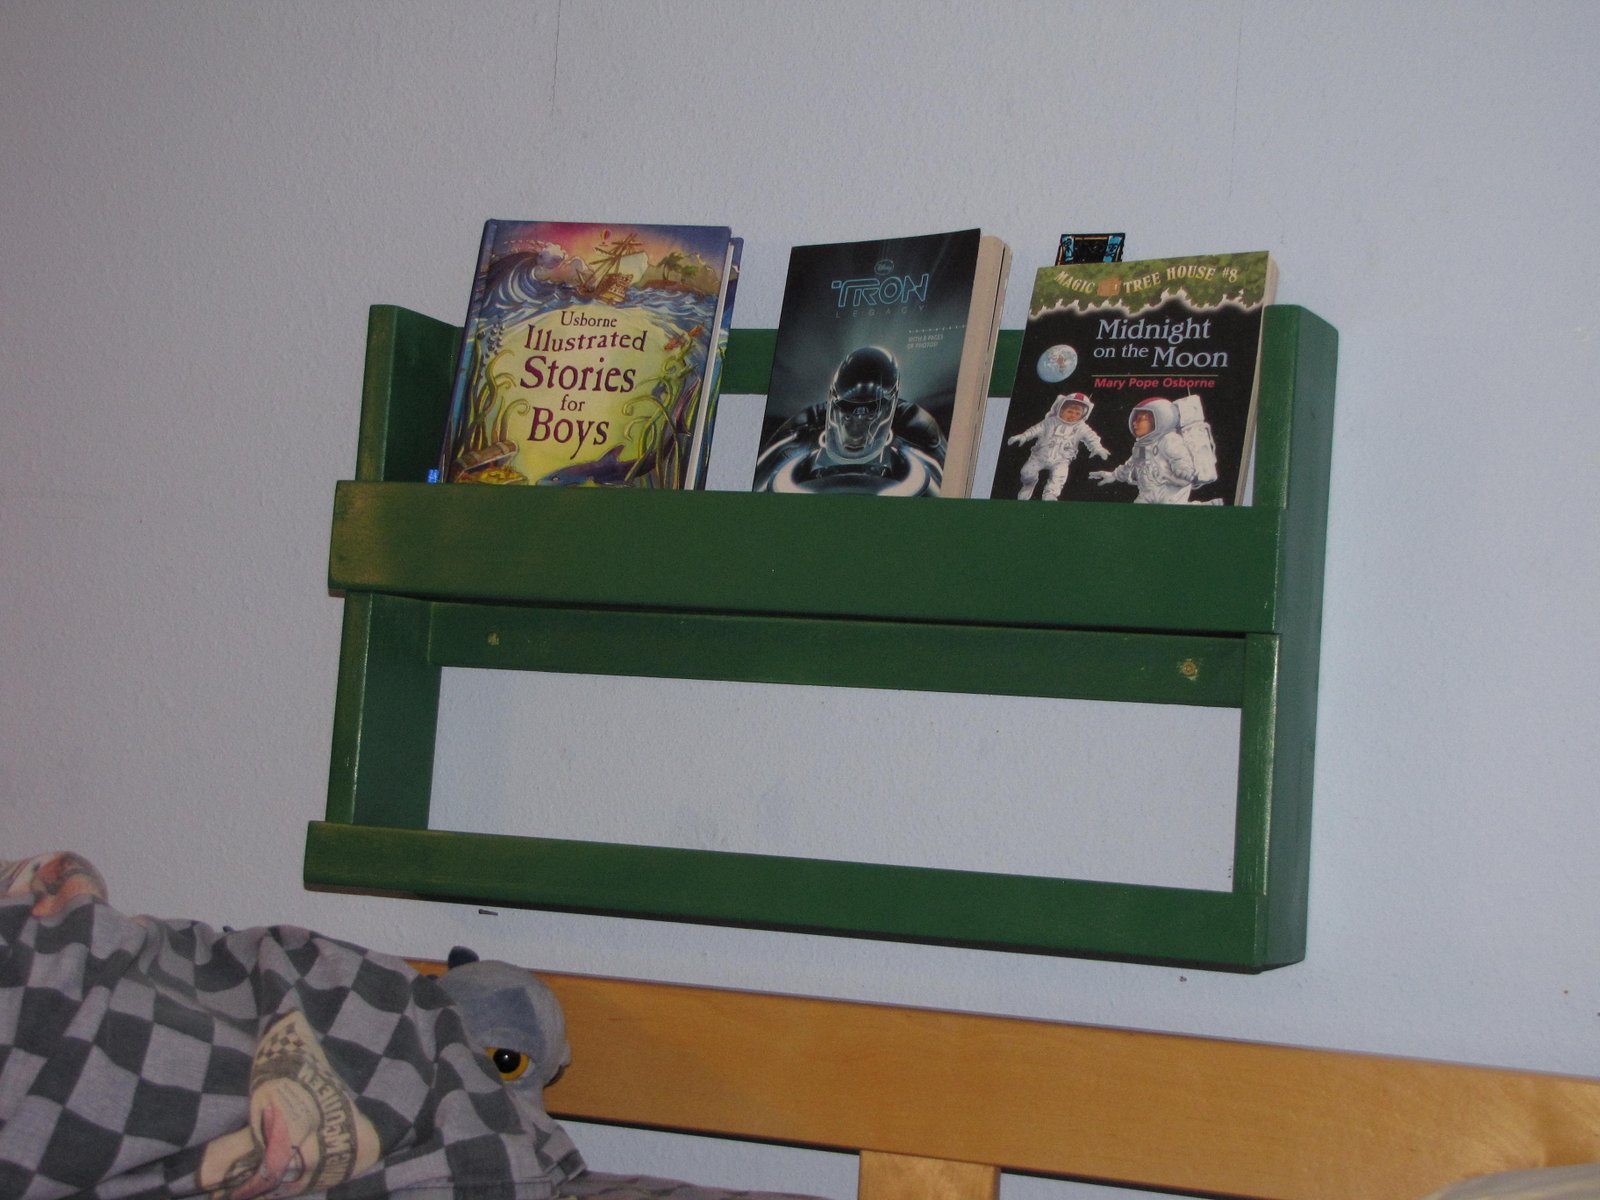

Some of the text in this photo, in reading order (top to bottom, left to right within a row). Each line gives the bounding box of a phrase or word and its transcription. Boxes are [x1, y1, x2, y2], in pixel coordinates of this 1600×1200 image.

[831, 273, 929, 307] TRON
[1054, 265, 1239, 295] MAGIC TREE HOUSE #8
[560, 310, 618, 328] Usborne
[1095, 316, 1212, 345] Midnight
[523, 323, 649, 352] Illustrated
[1093, 343, 1229, 369] on the Moon
[519, 355, 637, 392] Stories
[1094, 376, 1216, 391] Mary Pope Osborne
[560, 393, 586, 412] for
[527, 405, 611, 460] Boys
